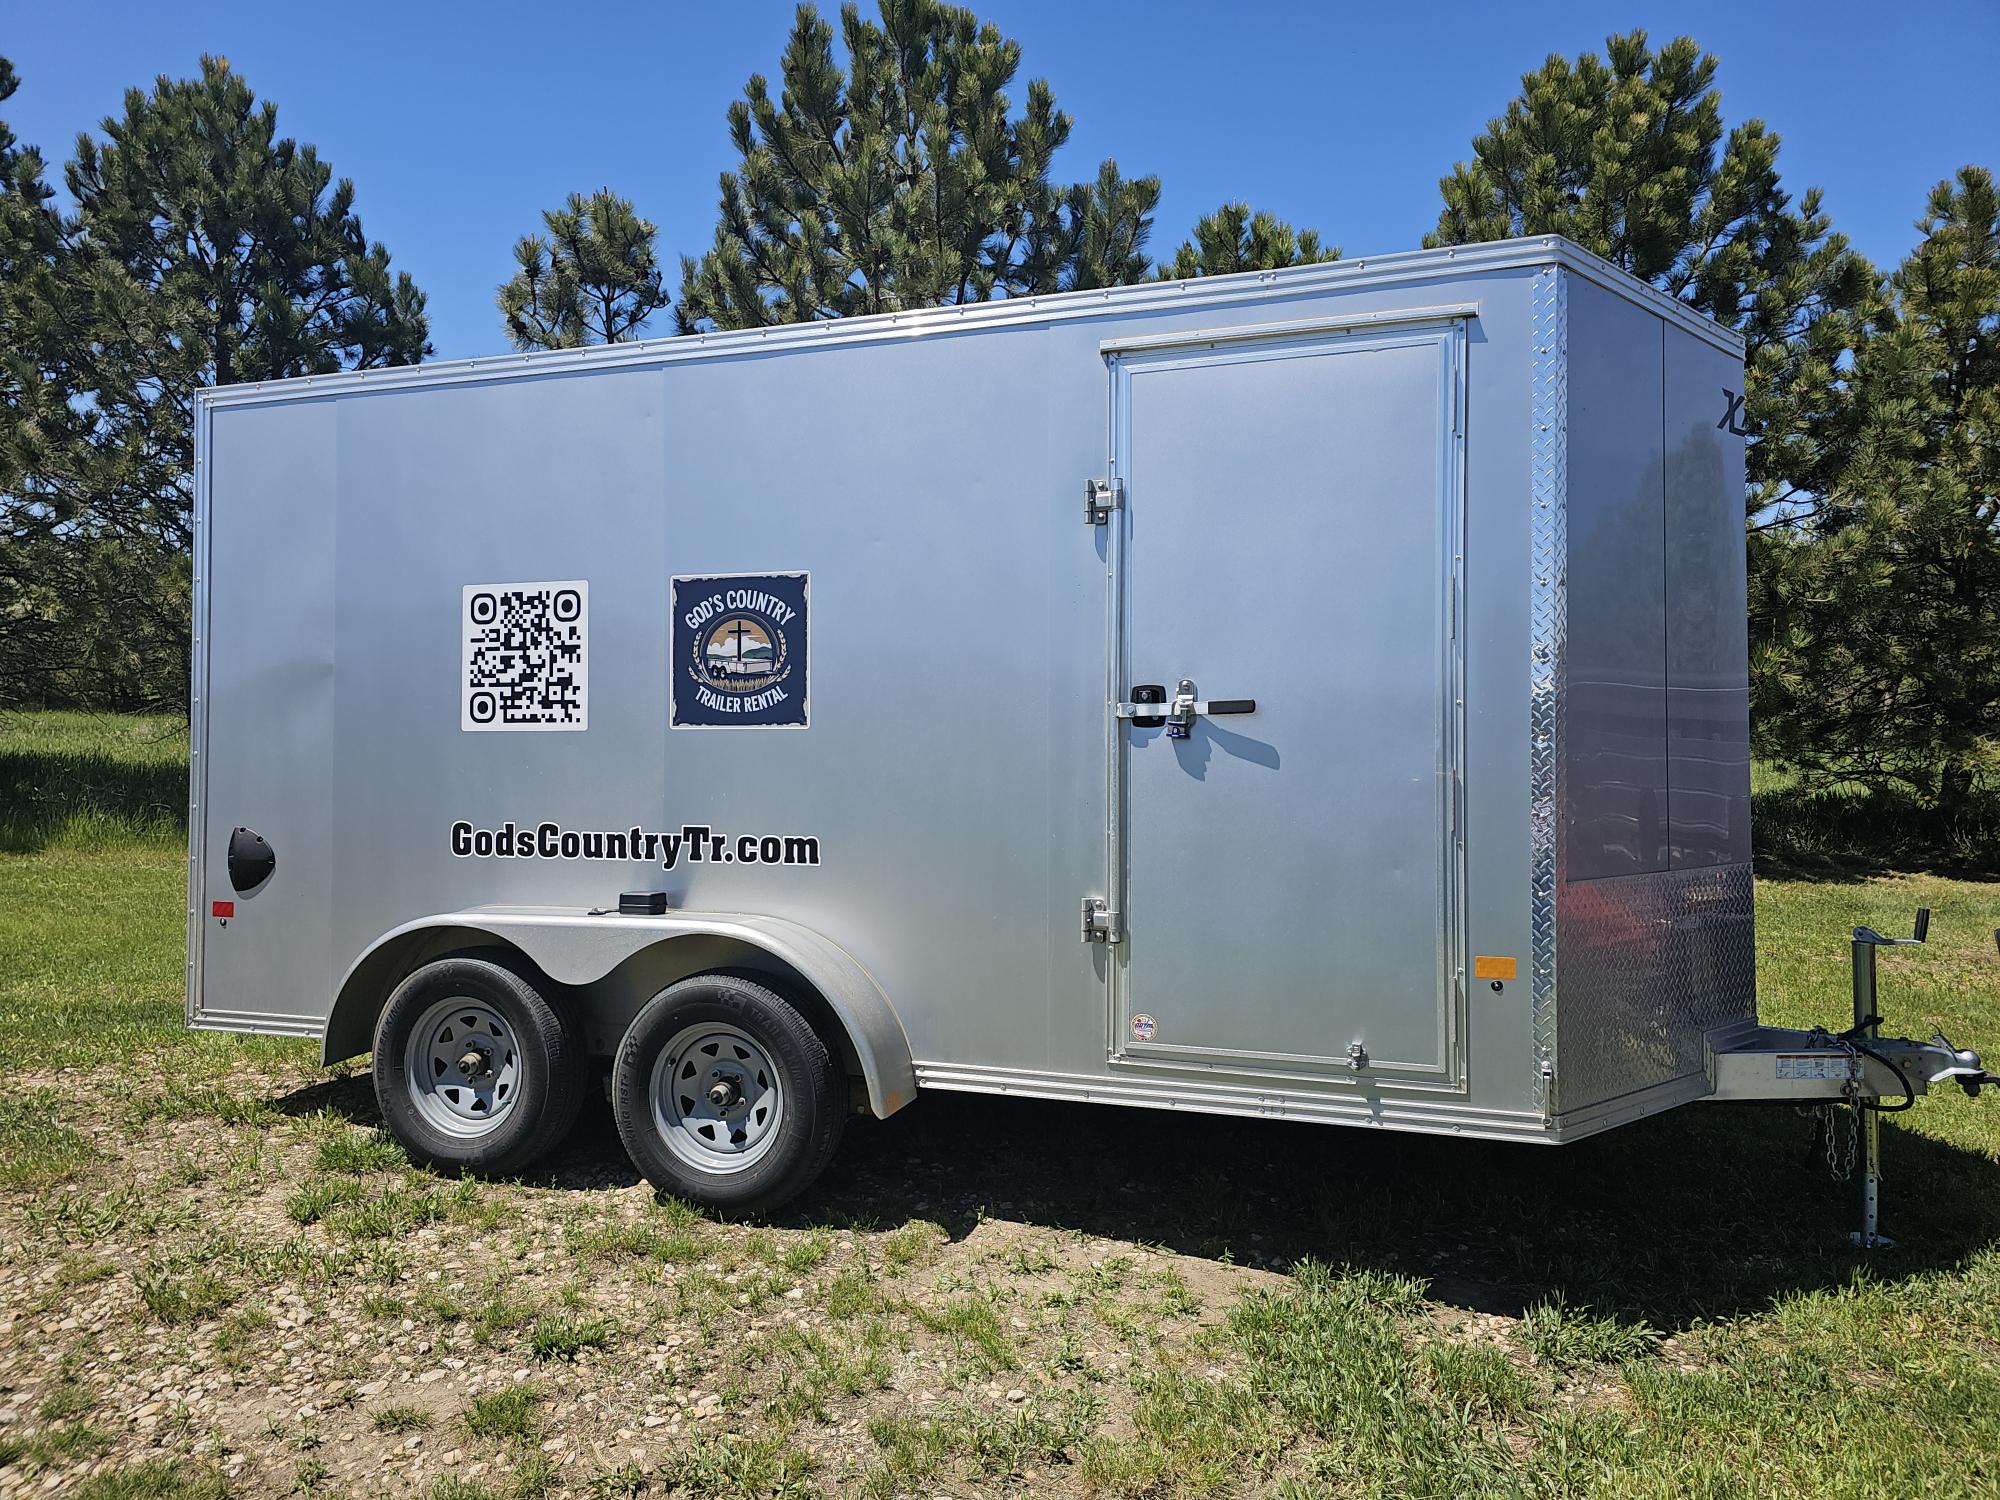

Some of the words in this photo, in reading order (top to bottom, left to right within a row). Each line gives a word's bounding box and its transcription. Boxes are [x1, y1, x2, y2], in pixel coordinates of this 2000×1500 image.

[685, 594, 725, 629] GOD'S
[726, 589, 796, 626] COUNTRY
[695, 685, 741, 713] TRAILER
[744, 685, 789, 713] RENTAL
[451, 821, 820, 871] GodsCountryTr.com
